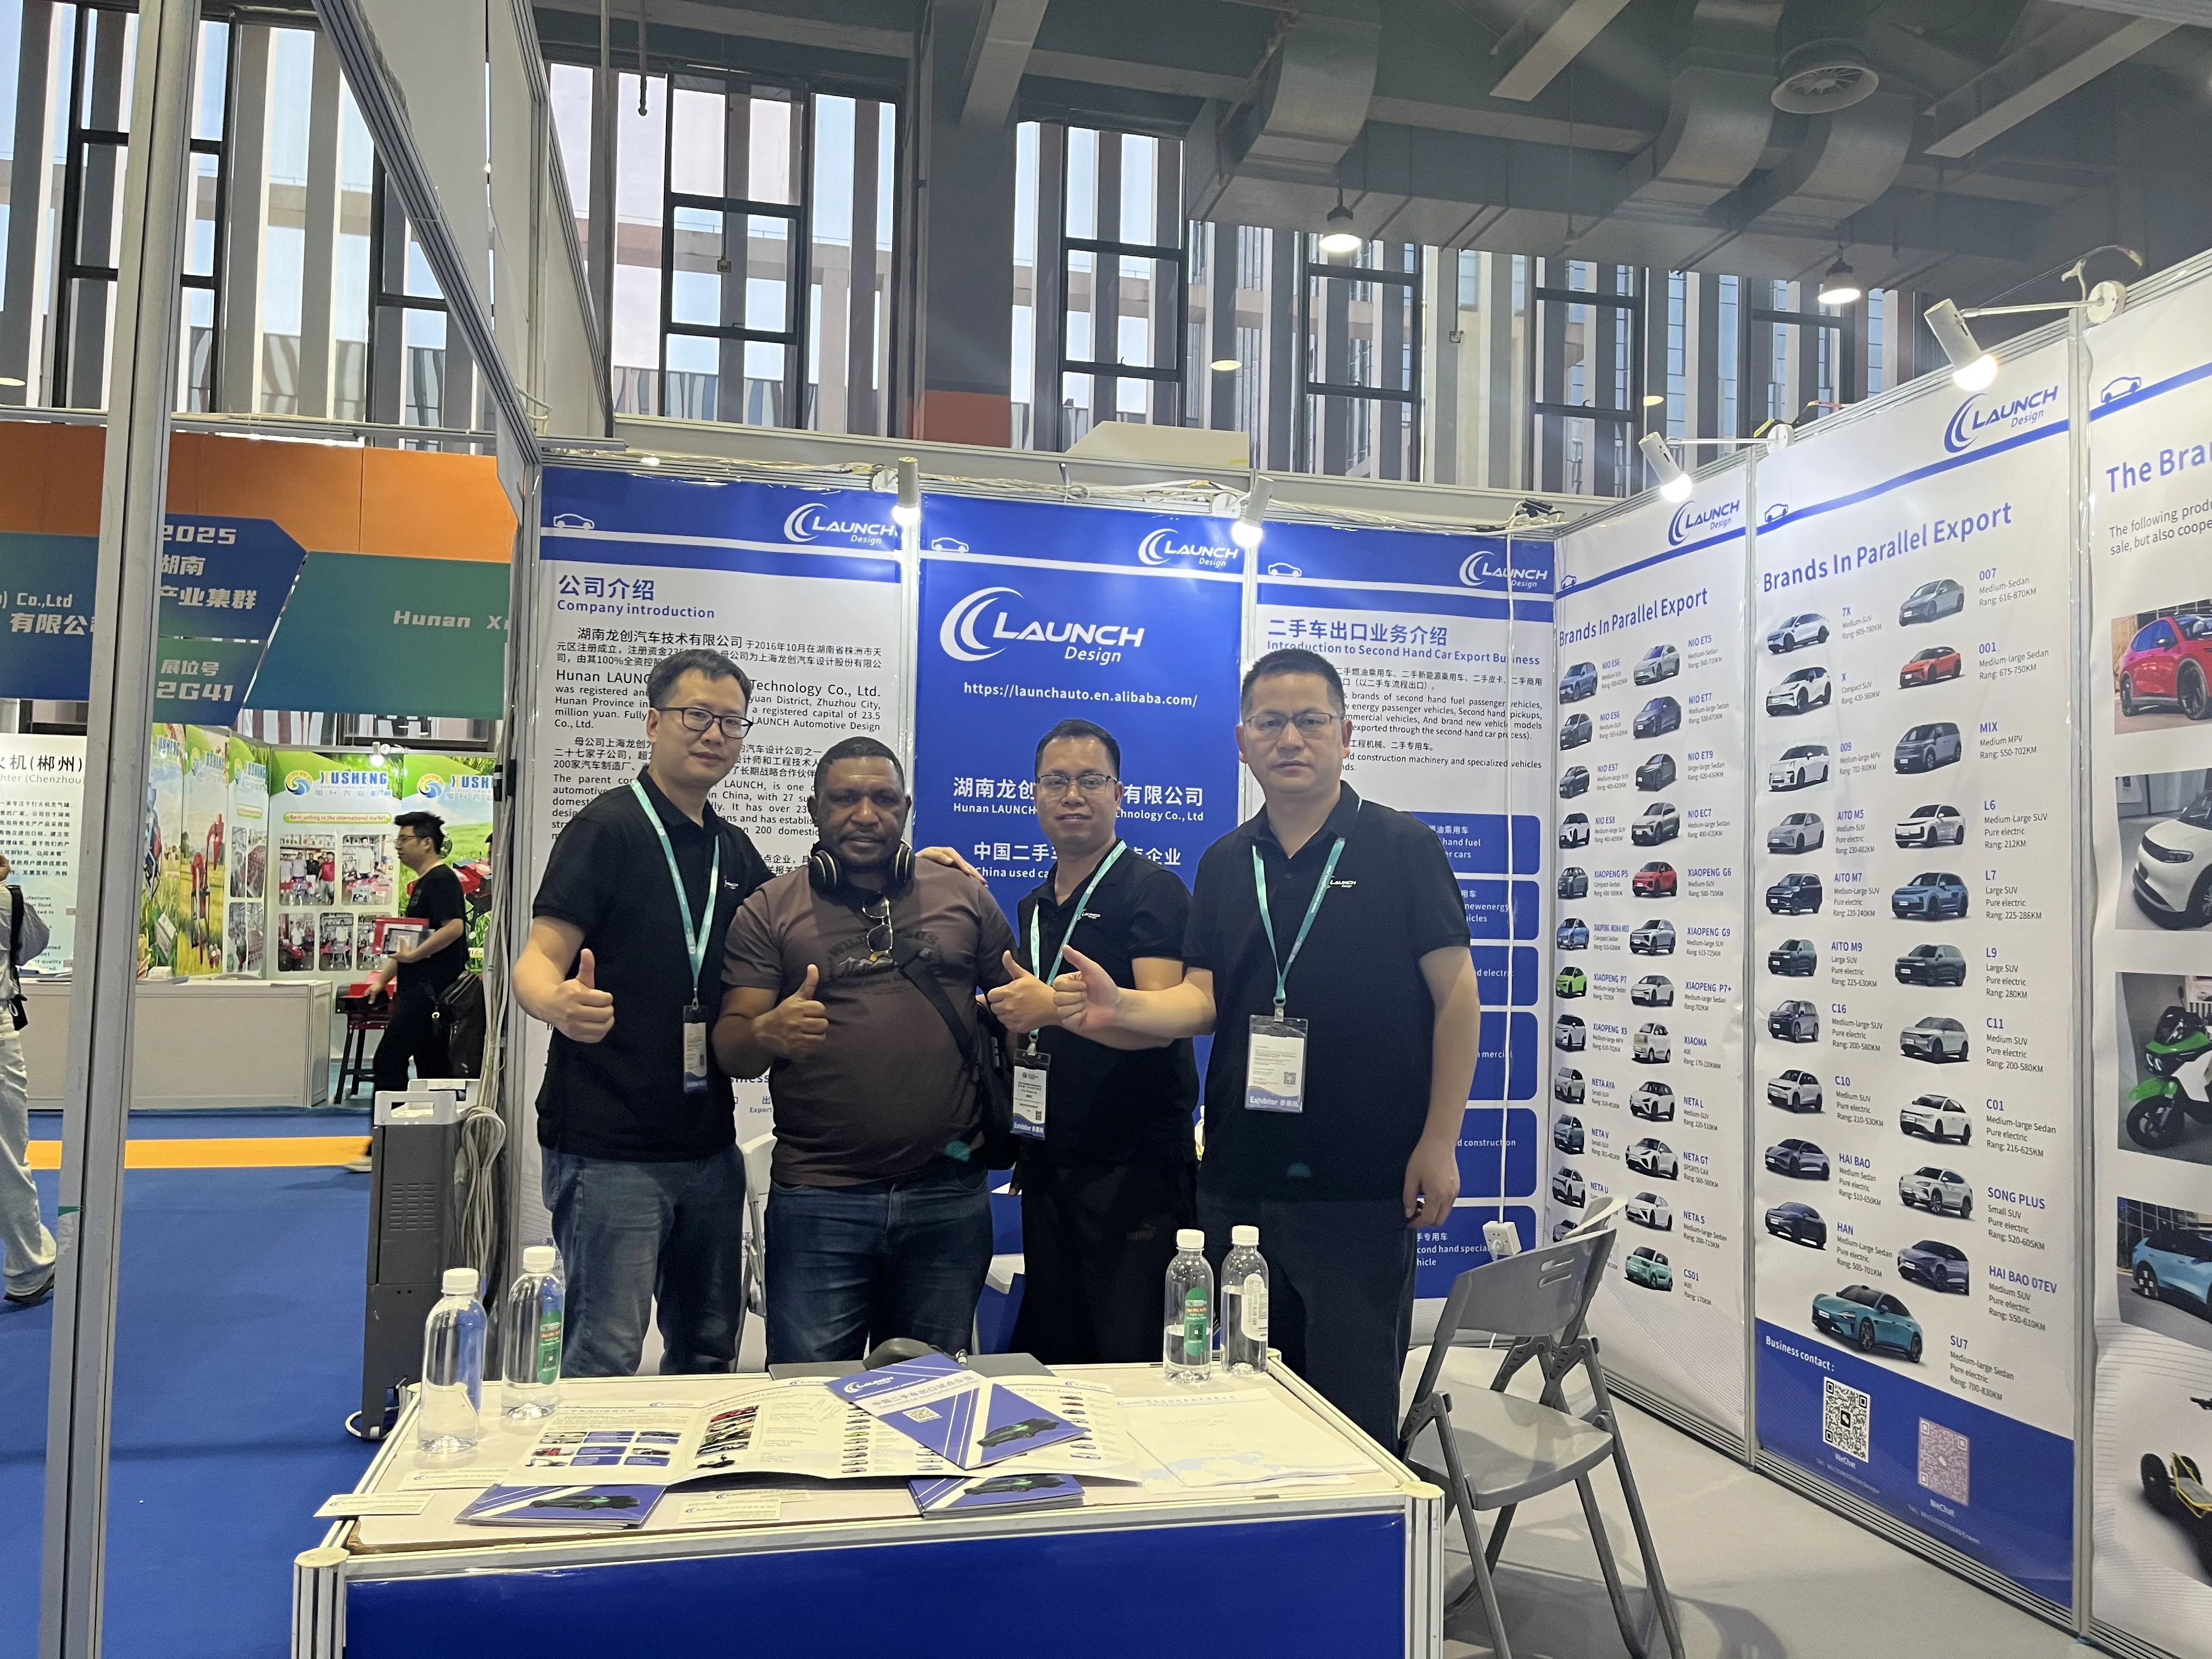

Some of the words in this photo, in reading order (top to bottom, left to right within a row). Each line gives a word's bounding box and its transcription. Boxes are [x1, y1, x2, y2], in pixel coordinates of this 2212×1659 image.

[1973, 386, 2058, 427] LAUNCH
[2011, 409, 2044, 428] Design
[2106, 461, 2152, 493] The
[1686, 500, 1740, 529] LAUNCH
[812, 516, 895, 536] LAUNCH
[1711, 517, 1731, 530] Design
[2109, 525, 2128, 538] The
[2131, 511, 2178, 532] following
[164, 525, 236, 544] 2025
[851, 535, 882, 545] Design
[2111, 541, 2132, 555] sale,
[2135, 534, 2150, 548] but
[2152, 529, 2175, 543] also
[1164, 540, 1238, 559] LAUNCH
[1763, 557, 1828, 594] Brands
[1833, 553, 1852, 575] In
[1857, 523, 1927, 568] Parallel
[1934, 503, 2012, 545] Export
[1199, 557, 1226, 567] Design
[1482, 562, 1548, 580] LAUNCH
[1979, 568, 1996, 581] 007
[559, 575, 654, 601] 公司介绍
[17, 592, 72, 608] Co.,Ltd
[557, 600, 623, 616] Company
[627, 603, 714, 618] introduction
[393, 610, 471, 628] Hunan
[1560, 622, 1596, 647] Brands
[1600, 619, 1609, 635] In
[1612, 601, 1658, 631] Parallel
[1661, 588, 1708, 617] Export
[993, 612, 1145, 647] LAUNCH
[1268, 619, 1447, 647] 二手车出口业务介绍
[578, 628, 742, 648] 湖南龙创汽车技术有限公司
[746, 640, 882, 657] 于2016年10月在湖南省株洲市天
[1688, 637, 1699, 647] NIO
[1979, 642, 1996, 654] 001
[1064, 646, 1121, 665] Design
[1359, 645, 1399, 656] Second
[1403, 647, 1432, 658] Hand
[1435, 650, 1452, 659] Car
[1454, 651, 1490, 663] Export
[161, 659, 219, 675] 展位号
[156, 681, 233, 701] 2G41
[557, 669, 600, 682] Hunan
[750, 680, 822, 697] Technology
[828, 685, 851, 697] Co.,
[858, 686, 881, 696] Ltd.
[579, 686, 628, 696] registered
[777, 696, 811, 707] District,
[817, 699, 856, 707] Zhuzhou
[861, 701, 881, 710] City,
[964, 682, 1198, 707] https://launchauto.en.alibaba.com/
[1352, 692, 1379, 700] brands
[1428, 695, 1446, 703] hand
[1469, 699, 1506, 710] passenger
[1689, 695, 1699, 704] NIO
[1701, 693, 1712, 703] ET7
[555, 696, 587, 705] Hunan
[593, 698, 634, 707] Province
[763, 707, 808, 716] registered
[812, 710, 843, 719] capital
[1352, 704, 1379, 712] energy
[1382, 705, 1421, 714] passenger
[1424, 707, 1456, 715] vehicles,
[1459, 708, 1485, 716] Second
[555, 708, 589, 716] million
[593, 711, 619, 719] yuan.
[625, 711, 647, 721] Fully
[793, 720, 846, 729] Automotive
[850, 722, 880, 732] Design
[555, 719, 573, 729] Co.,
[576, 720, 594, 729] Ltd.
[1386, 715, 1420, 724] vehicles,
[1442, 717, 1463, 725] brand
[1514, 721, 1542, 730] models
[1980, 722, 1998, 733] MIX
[1390, 726, 1420, 735] through
[1436, 729, 1483, 737] second-hand
[1358, 754, 1406, 763] construction
[1409, 756, 1449, 766] machinery
[1688, 752, 1699, 761] NIO
[320, 772, 387, 785] XUSHENG
[553, 774, 571, 782] The
[579, 776, 611, 785] parent
[725, 780, 766, 791] LAUNCH,
[723, 791, 752, 802] China,
[953, 777, 1035, 800] 湖南龙创
[1124, 784, 1203, 806] 有限公司
[953, 803, 989, 813] Hunan
[992, 805, 1036, 815] LAUNCH
[1165, 811, 1185, 822] Co.,
[1188, 812, 1204, 821] Ltd
[1984, 800, 1995, 810] L6
[1688, 810, 1699, 818] NIO
[1443, 838, 1463, 846] hand
[1009, 868, 1035, 878] used
[1688, 868, 1720, 877] XIAOPENG
[1986, 871, 1996, 881] L7
[1687, 927, 1719, 936] XIAOPENG
[1987, 947, 1996, 958] L9
[1685, 981, 1718, 991] XIAOPENG
[1832, 1003, 1846, 1014] C16
[1987, 1018, 2004, 1030] C11
[1684, 1036, 1707, 1047] XIAOMA
[1835, 1076, 1850, 1086] C10
[1250, 1096, 1278, 1105] Exhibitor
[1986, 1099, 2004, 1111] C01
[1988, 1187, 2016, 1204] SONG
[2019, 1194, 2045, 1210] PLUS
[1837, 1222, 1854, 1235] HAN
[1989, 1265, 2006, 1280] HAI
[2009, 1271, 2029, 1286] BAO
[2032, 1277, 2057, 1294] 07EV
[1766, 1335, 1799, 1359] Business
[1950, 1335, 1968, 1350] SU7
